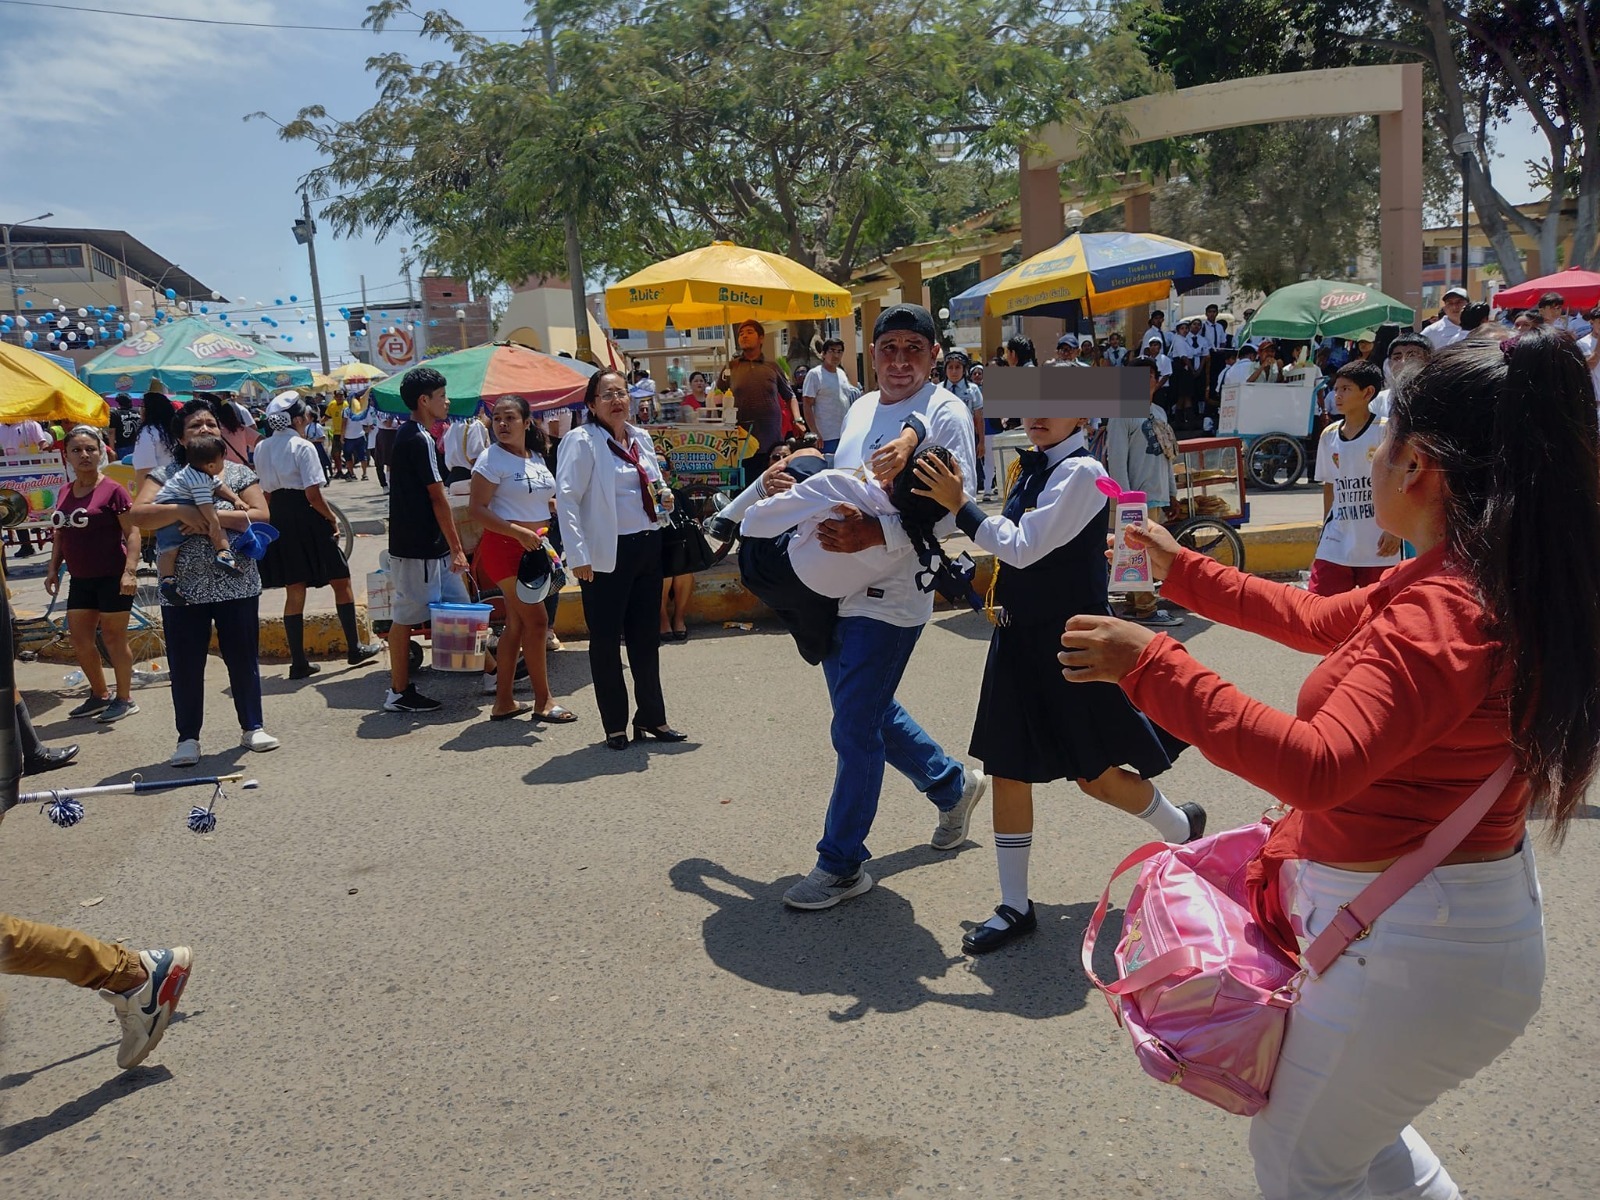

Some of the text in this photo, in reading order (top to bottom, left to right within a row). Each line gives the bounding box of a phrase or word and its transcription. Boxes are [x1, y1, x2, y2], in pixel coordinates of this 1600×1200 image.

[638, 288, 664, 301] bite
[730, 290, 763, 306] bitel
[1320, 292, 1366, 310] Pilsen
[671, 452, 717, 461] DE HIELO
[675, 461, 713, 471] CASERO
